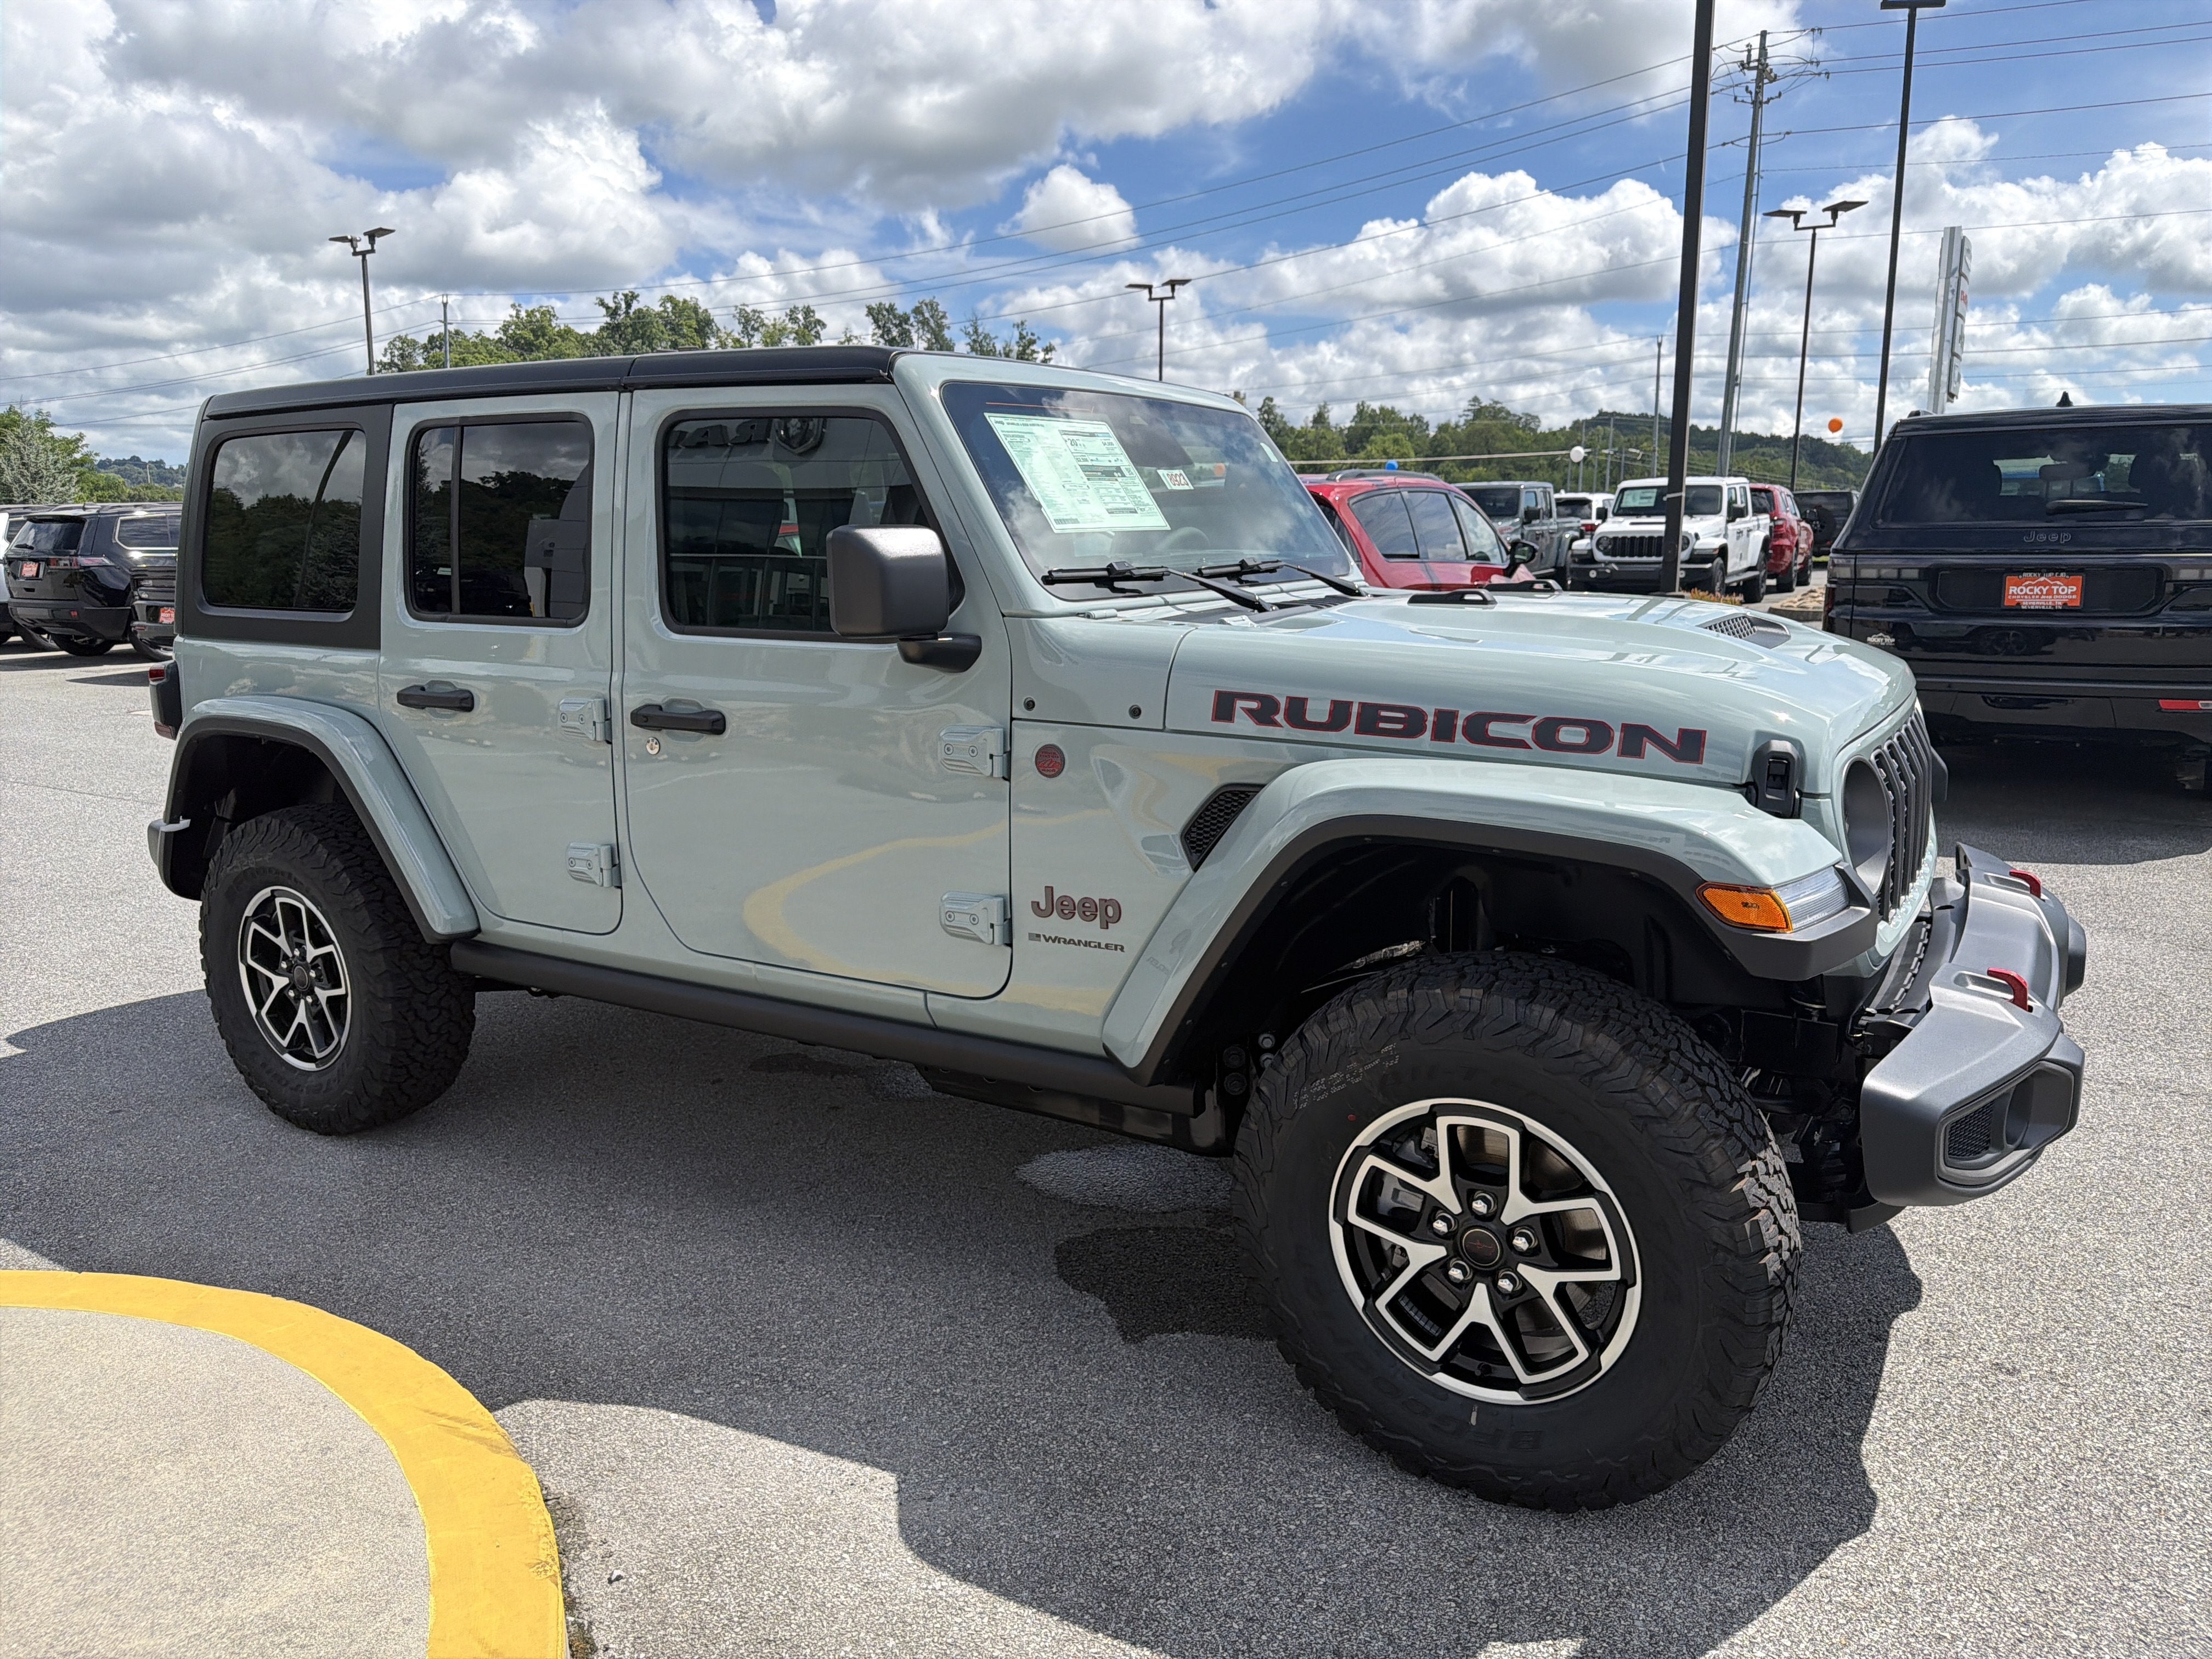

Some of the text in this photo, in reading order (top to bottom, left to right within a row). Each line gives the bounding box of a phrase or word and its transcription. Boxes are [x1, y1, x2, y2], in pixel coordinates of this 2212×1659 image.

[1166, 473, 1189, 487] 8923
[2023, 531, 2072, 543] Jeep
[2008, 586, 2077, 595] ROCKY TOP
[1211, 690, 1707, 765] RUBICON
[1031, 885, 1122, 929] Jeep
[1041, 934, 1125, 953] WRANGLER
